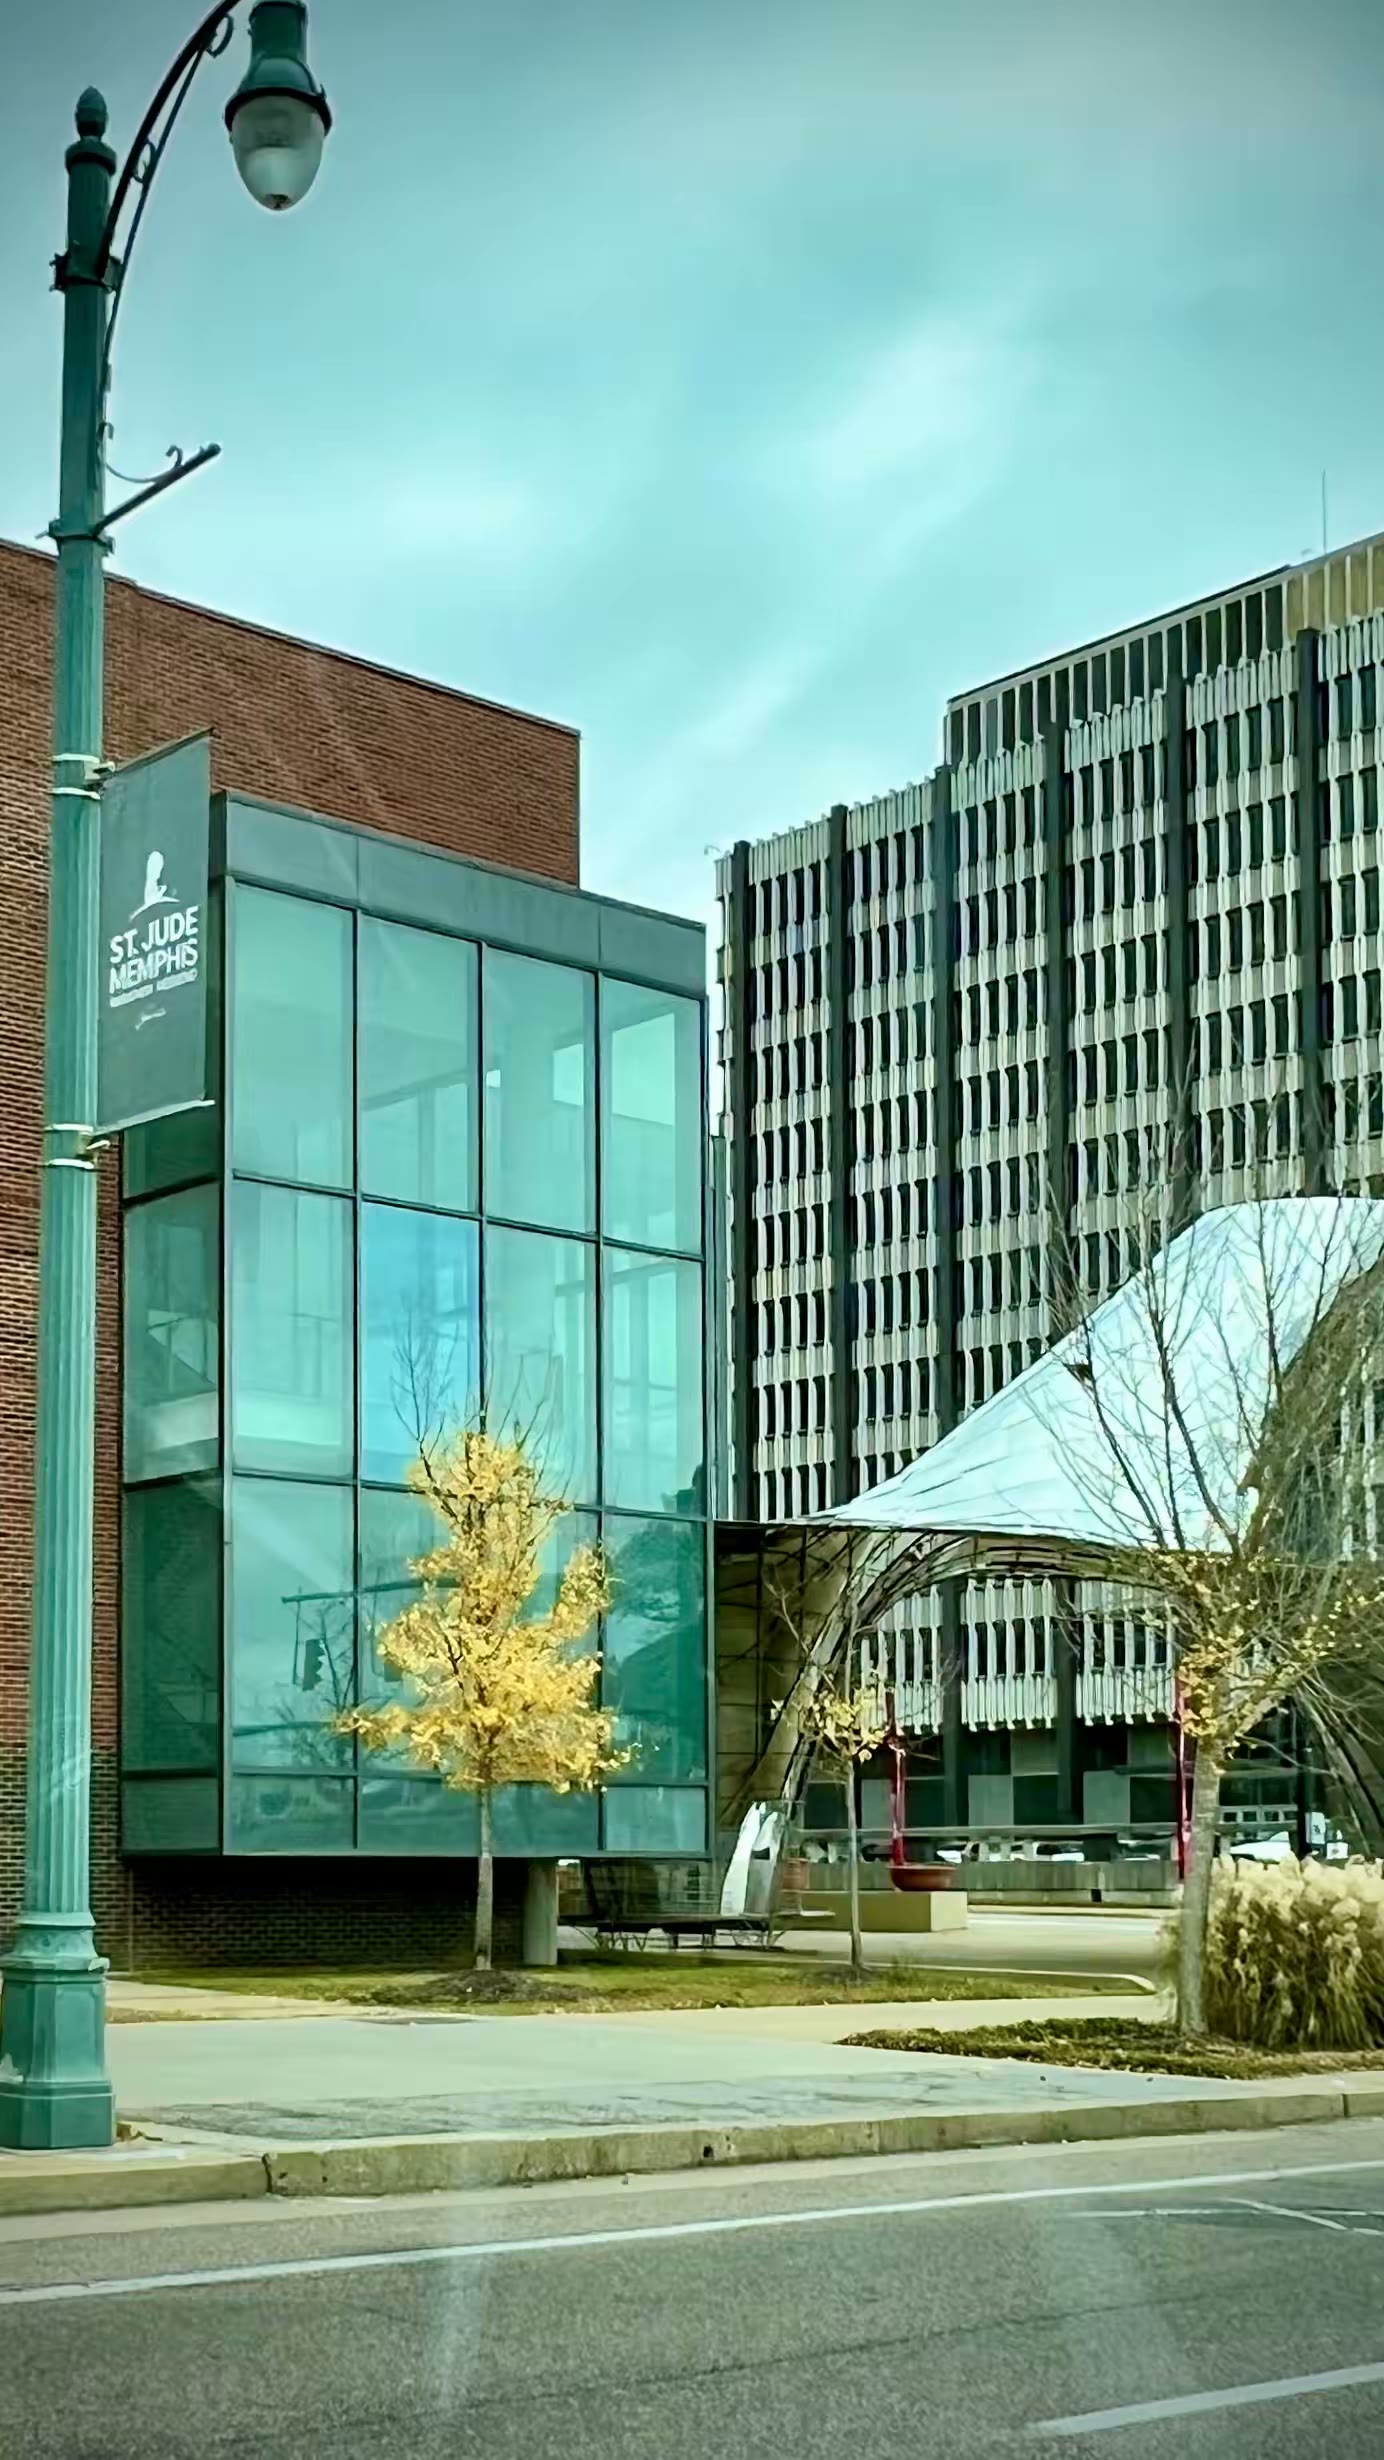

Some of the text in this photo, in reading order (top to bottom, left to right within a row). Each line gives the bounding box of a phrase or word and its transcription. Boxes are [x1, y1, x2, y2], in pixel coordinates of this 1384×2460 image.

[110, 906, 198, 963] ST. JUDE
[109, 938, 198, 994] MEMPHIS
